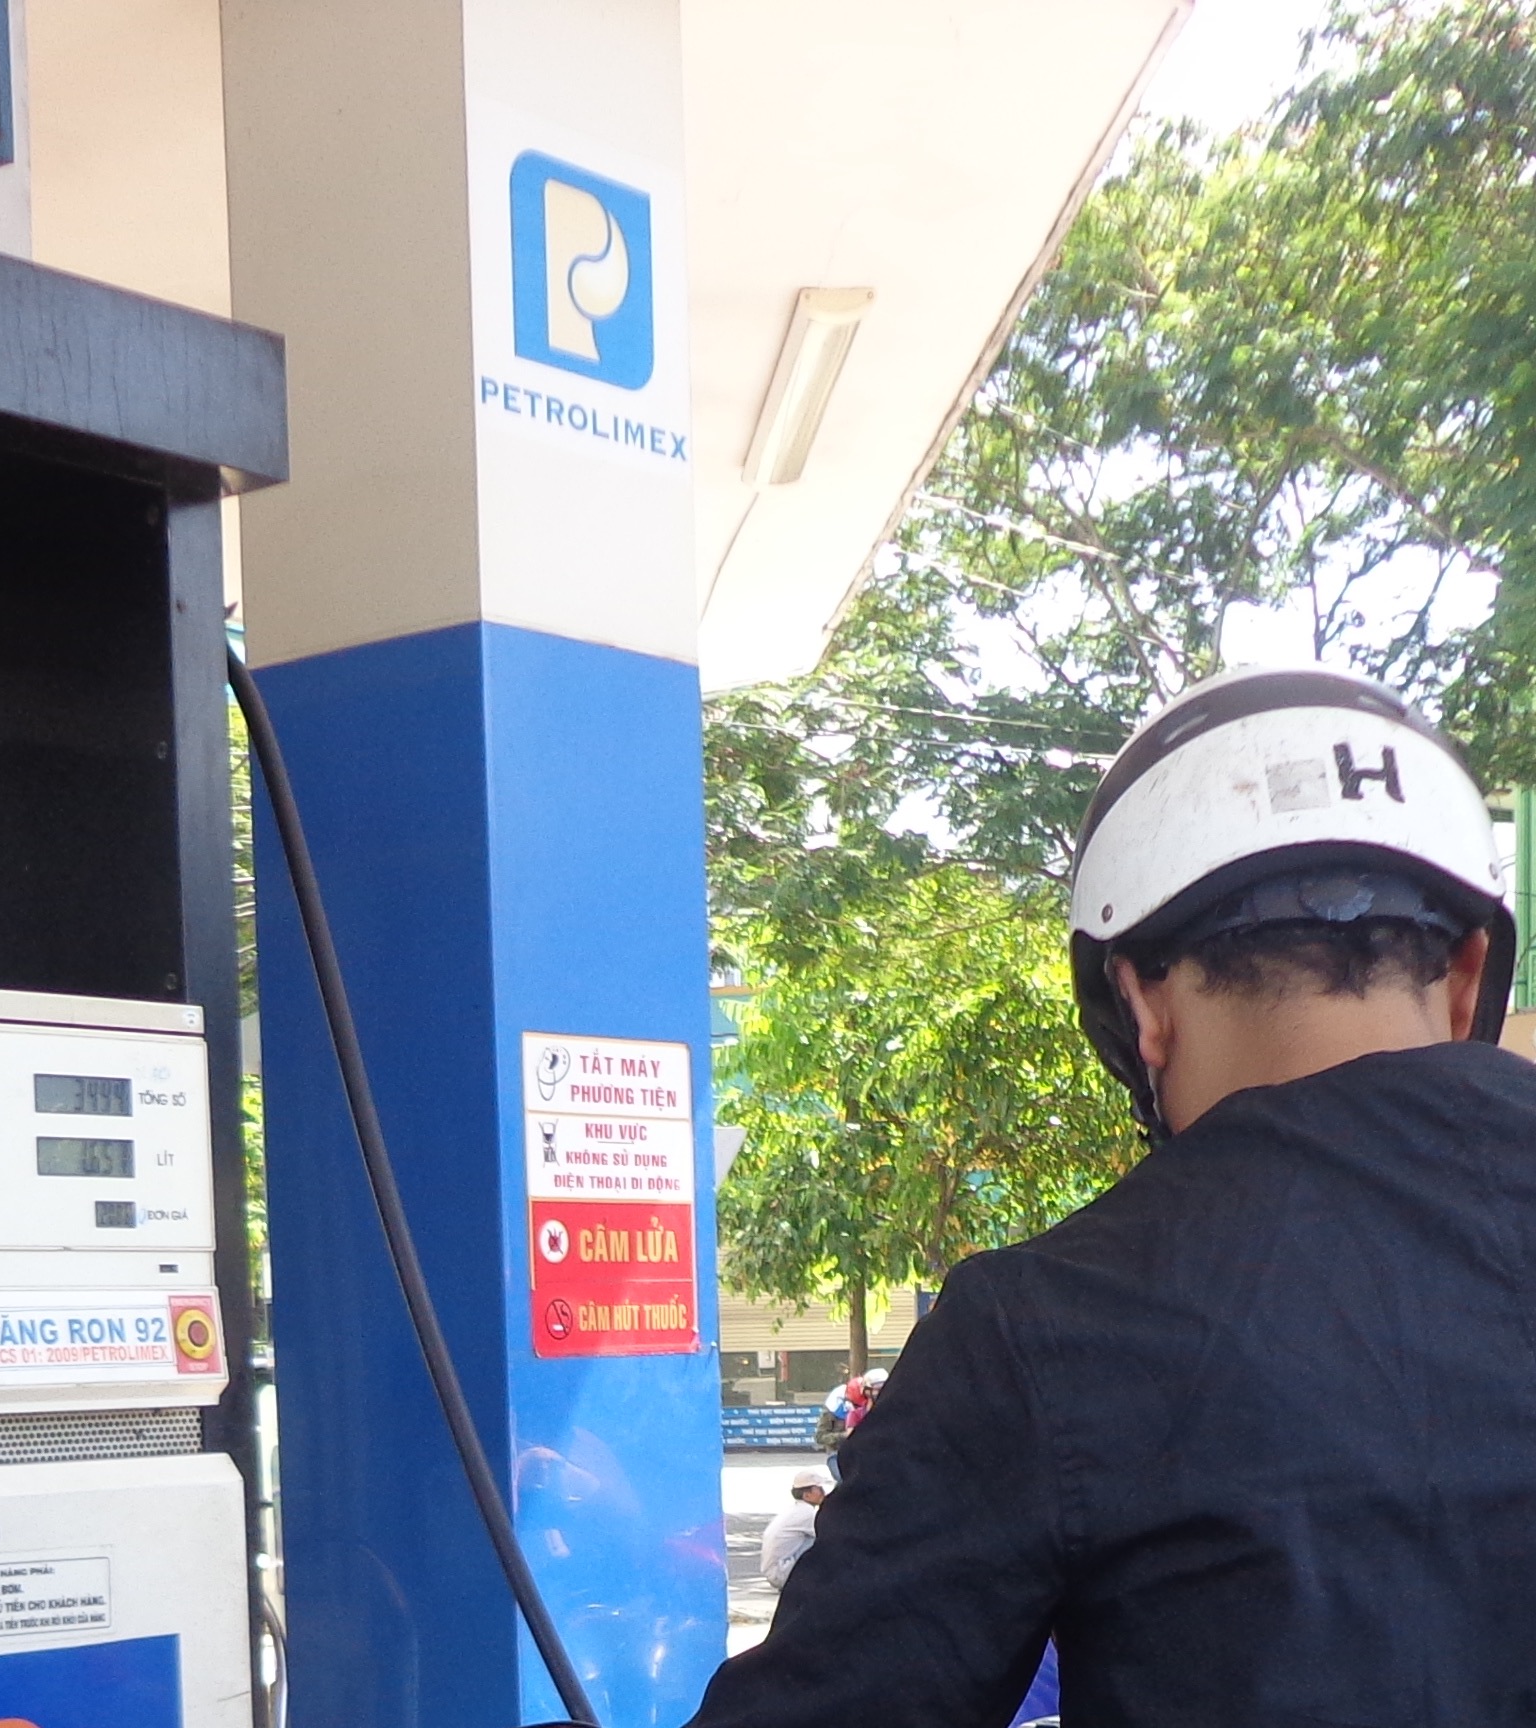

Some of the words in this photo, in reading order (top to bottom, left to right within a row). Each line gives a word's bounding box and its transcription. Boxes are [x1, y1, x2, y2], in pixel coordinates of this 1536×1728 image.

[480, 375, 689, 463] PETROLIMEX
[1333, 742, 1405, 804] H
[580, 1048, 614, 1076] TẮT
[621, 1054, 661, 1079] MÁY
[570, 1083, 635, 1106] PHƯƠNG
[640, 1086, 677, 1112] TIỆN
[585, 1122, 613, 1140] KHU
[619, 1122, 648, 1144] VỰC
[157, 1150, 174, 1167] LÍT
[566, 1149, 609, 1166] KHÔNG
[634, 1154, 668, 1171] DỤNG
[554, 1172, 585, 1192] ĐIỆN
[589, 1175, 627, 1194] THOẠI
[631, 1177, 643, 1190] DI
[647, 1175, 681, 1195] ĐỘNG
[636, 1216, 679, 1263] LỬA
[613, 1299, 640, 1331] HÚT
[644, 1293, 688, 1331] THUỐC
[67, 1317, 127, 1345] RON
[135, 1317, 167, 1343] 92
[22, 1348, 43, 1364] 01:
